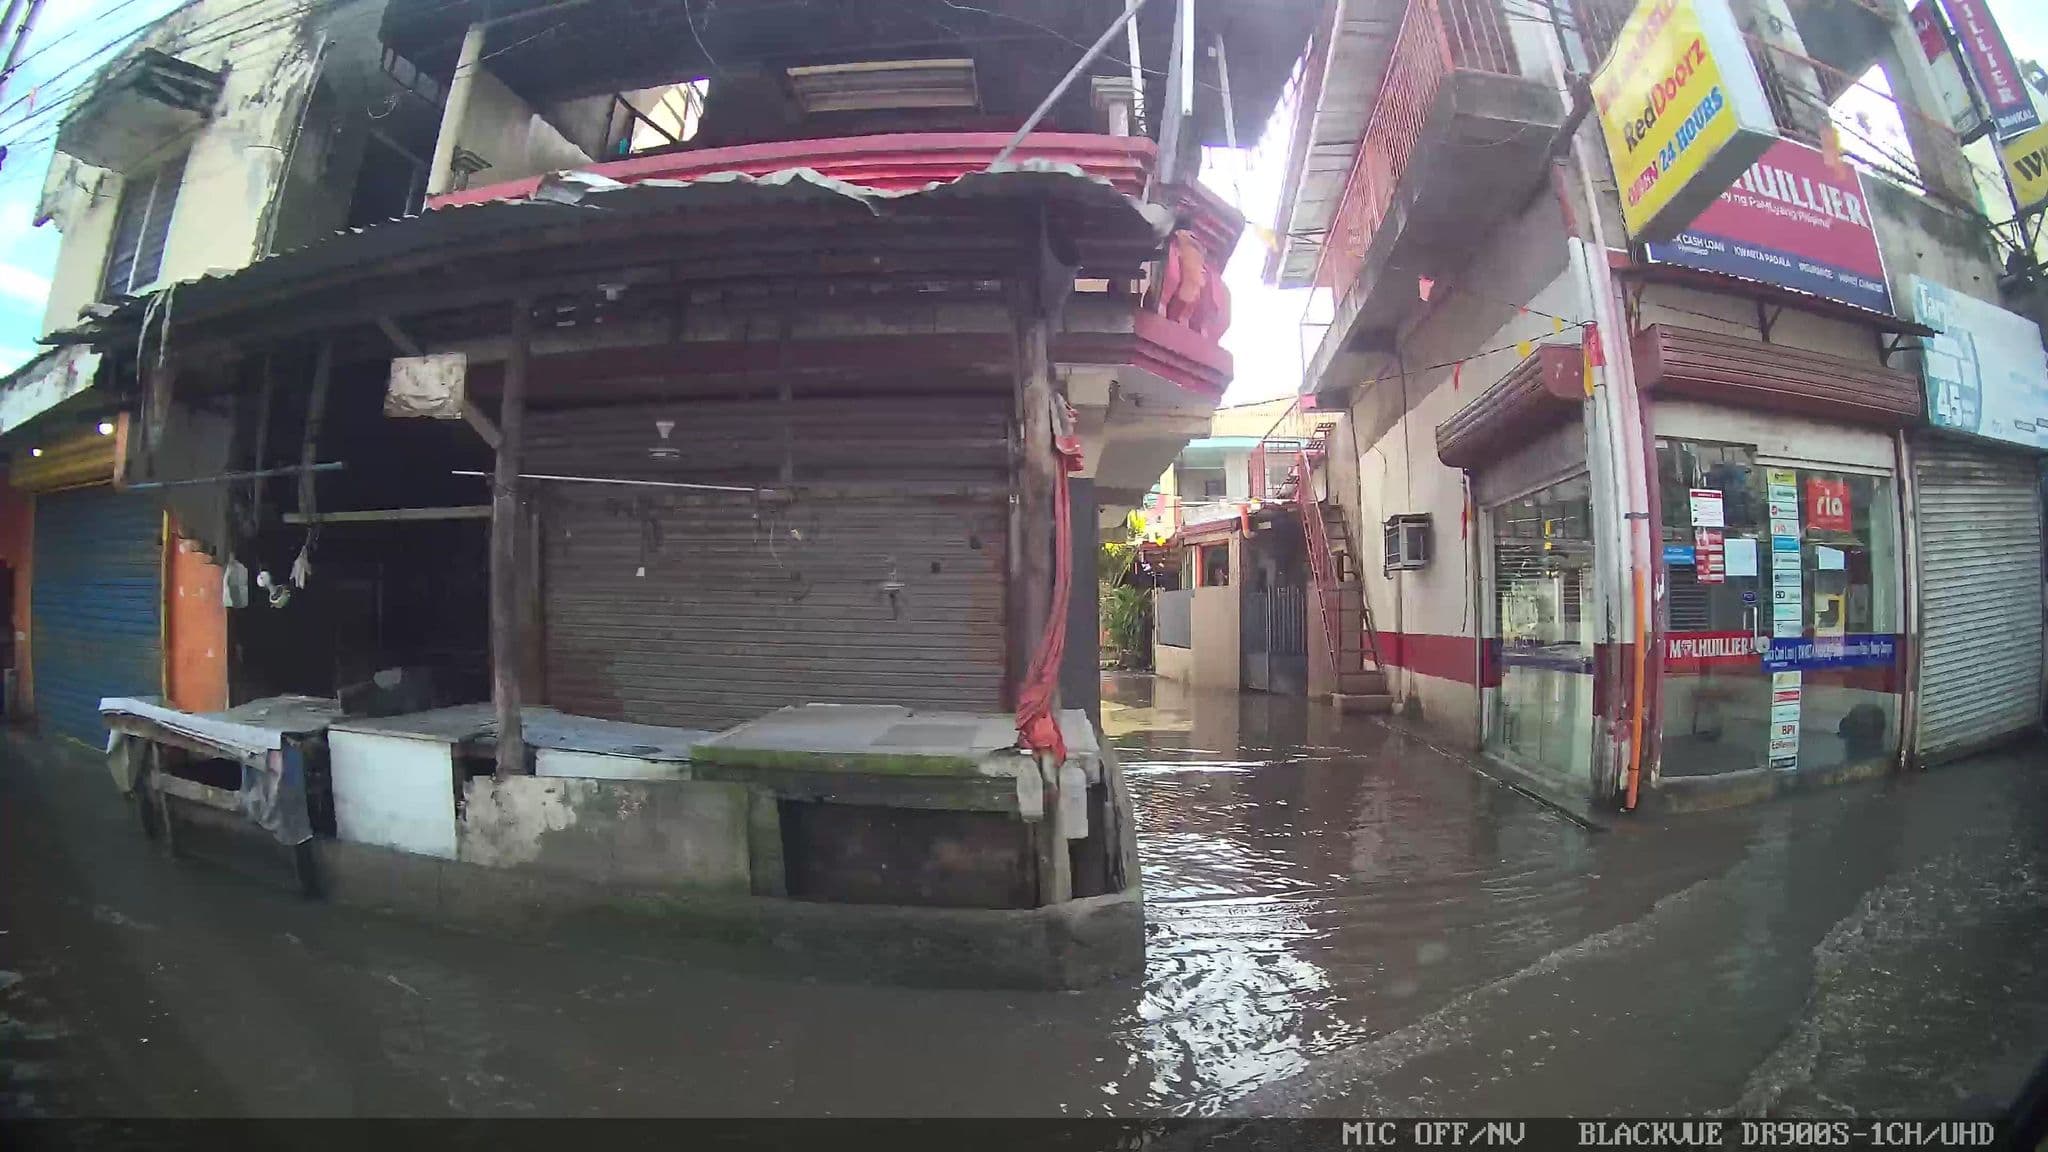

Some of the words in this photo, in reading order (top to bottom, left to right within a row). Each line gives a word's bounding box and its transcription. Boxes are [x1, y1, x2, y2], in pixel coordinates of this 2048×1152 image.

[1623, 38, 1706, 154] RedDoorz
[1659, 141, 1677, 172] 24
[1675, 85, 1724, 156] HOURS
[1682, 234, 1704, 247] CASH
[1704, 240, 1725, 252] LOAN
[1816, 488, 1844, 516] ria
[1781, 724, 1796, 735] BPI
